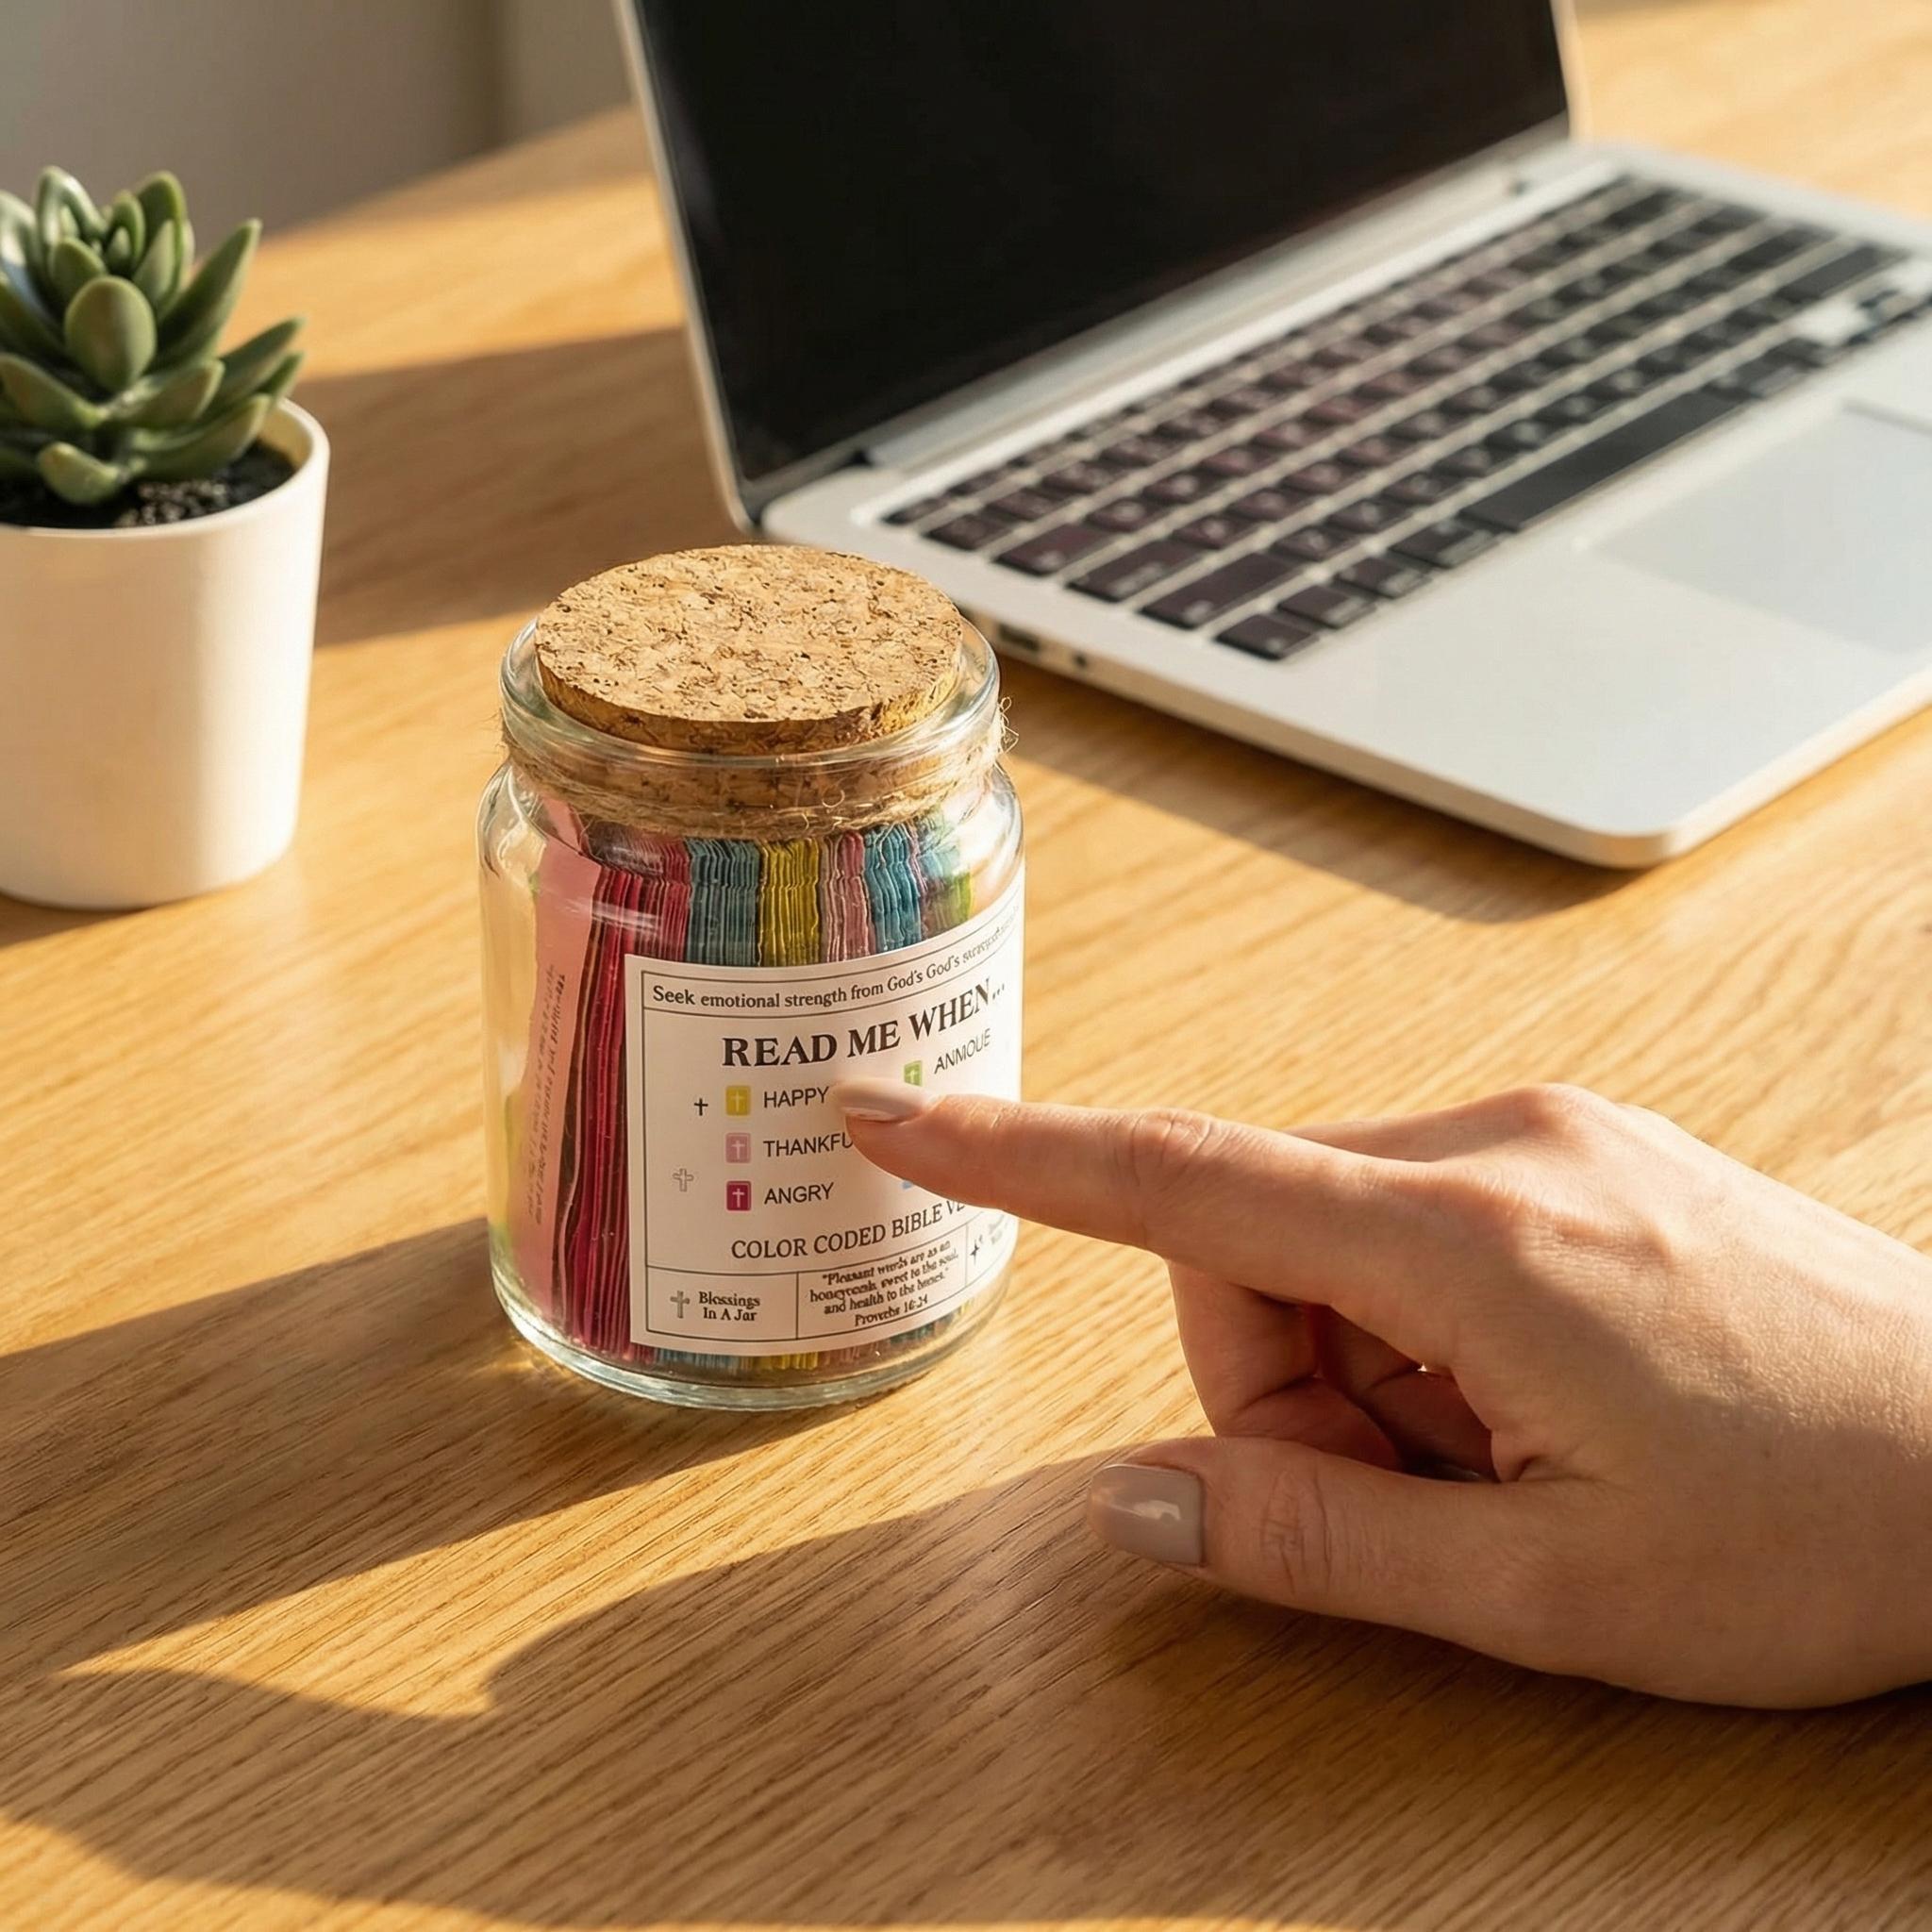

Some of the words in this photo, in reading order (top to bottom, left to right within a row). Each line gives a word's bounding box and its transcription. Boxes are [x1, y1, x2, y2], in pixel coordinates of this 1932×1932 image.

[653, 985, 695, 1005] Seek
[701, 993, 780, 1008] emotional
[785, 988, 847, 1008] strength
[851, 983, 884, 1001] from
[888, 969, 924, 991] God's
[926, 955, 960, 980] God's
[723, 1034, 838, 1067] READ
[847, 1020, 901, 1058] ME
[763, 1086, 829, 1108] HAPPY
[764, 1182, 834, 1205] ANGRY
[731, 1238, 808, 1259] COLOR
[813, 1224, 886, 1255] CODED
[891, 1203, 942, 1239] BIBLE
[824, 1302, 846, 1314] and
[850, 1291, 884, 1310] health
[887, 1291, 897, 1302] to
[899, 1283, 915, 1297] the
[703, 1307, 717, 1319] In
[720, 1307, 731, 1321] A
[734, 1308, 758, 1322] Jar
